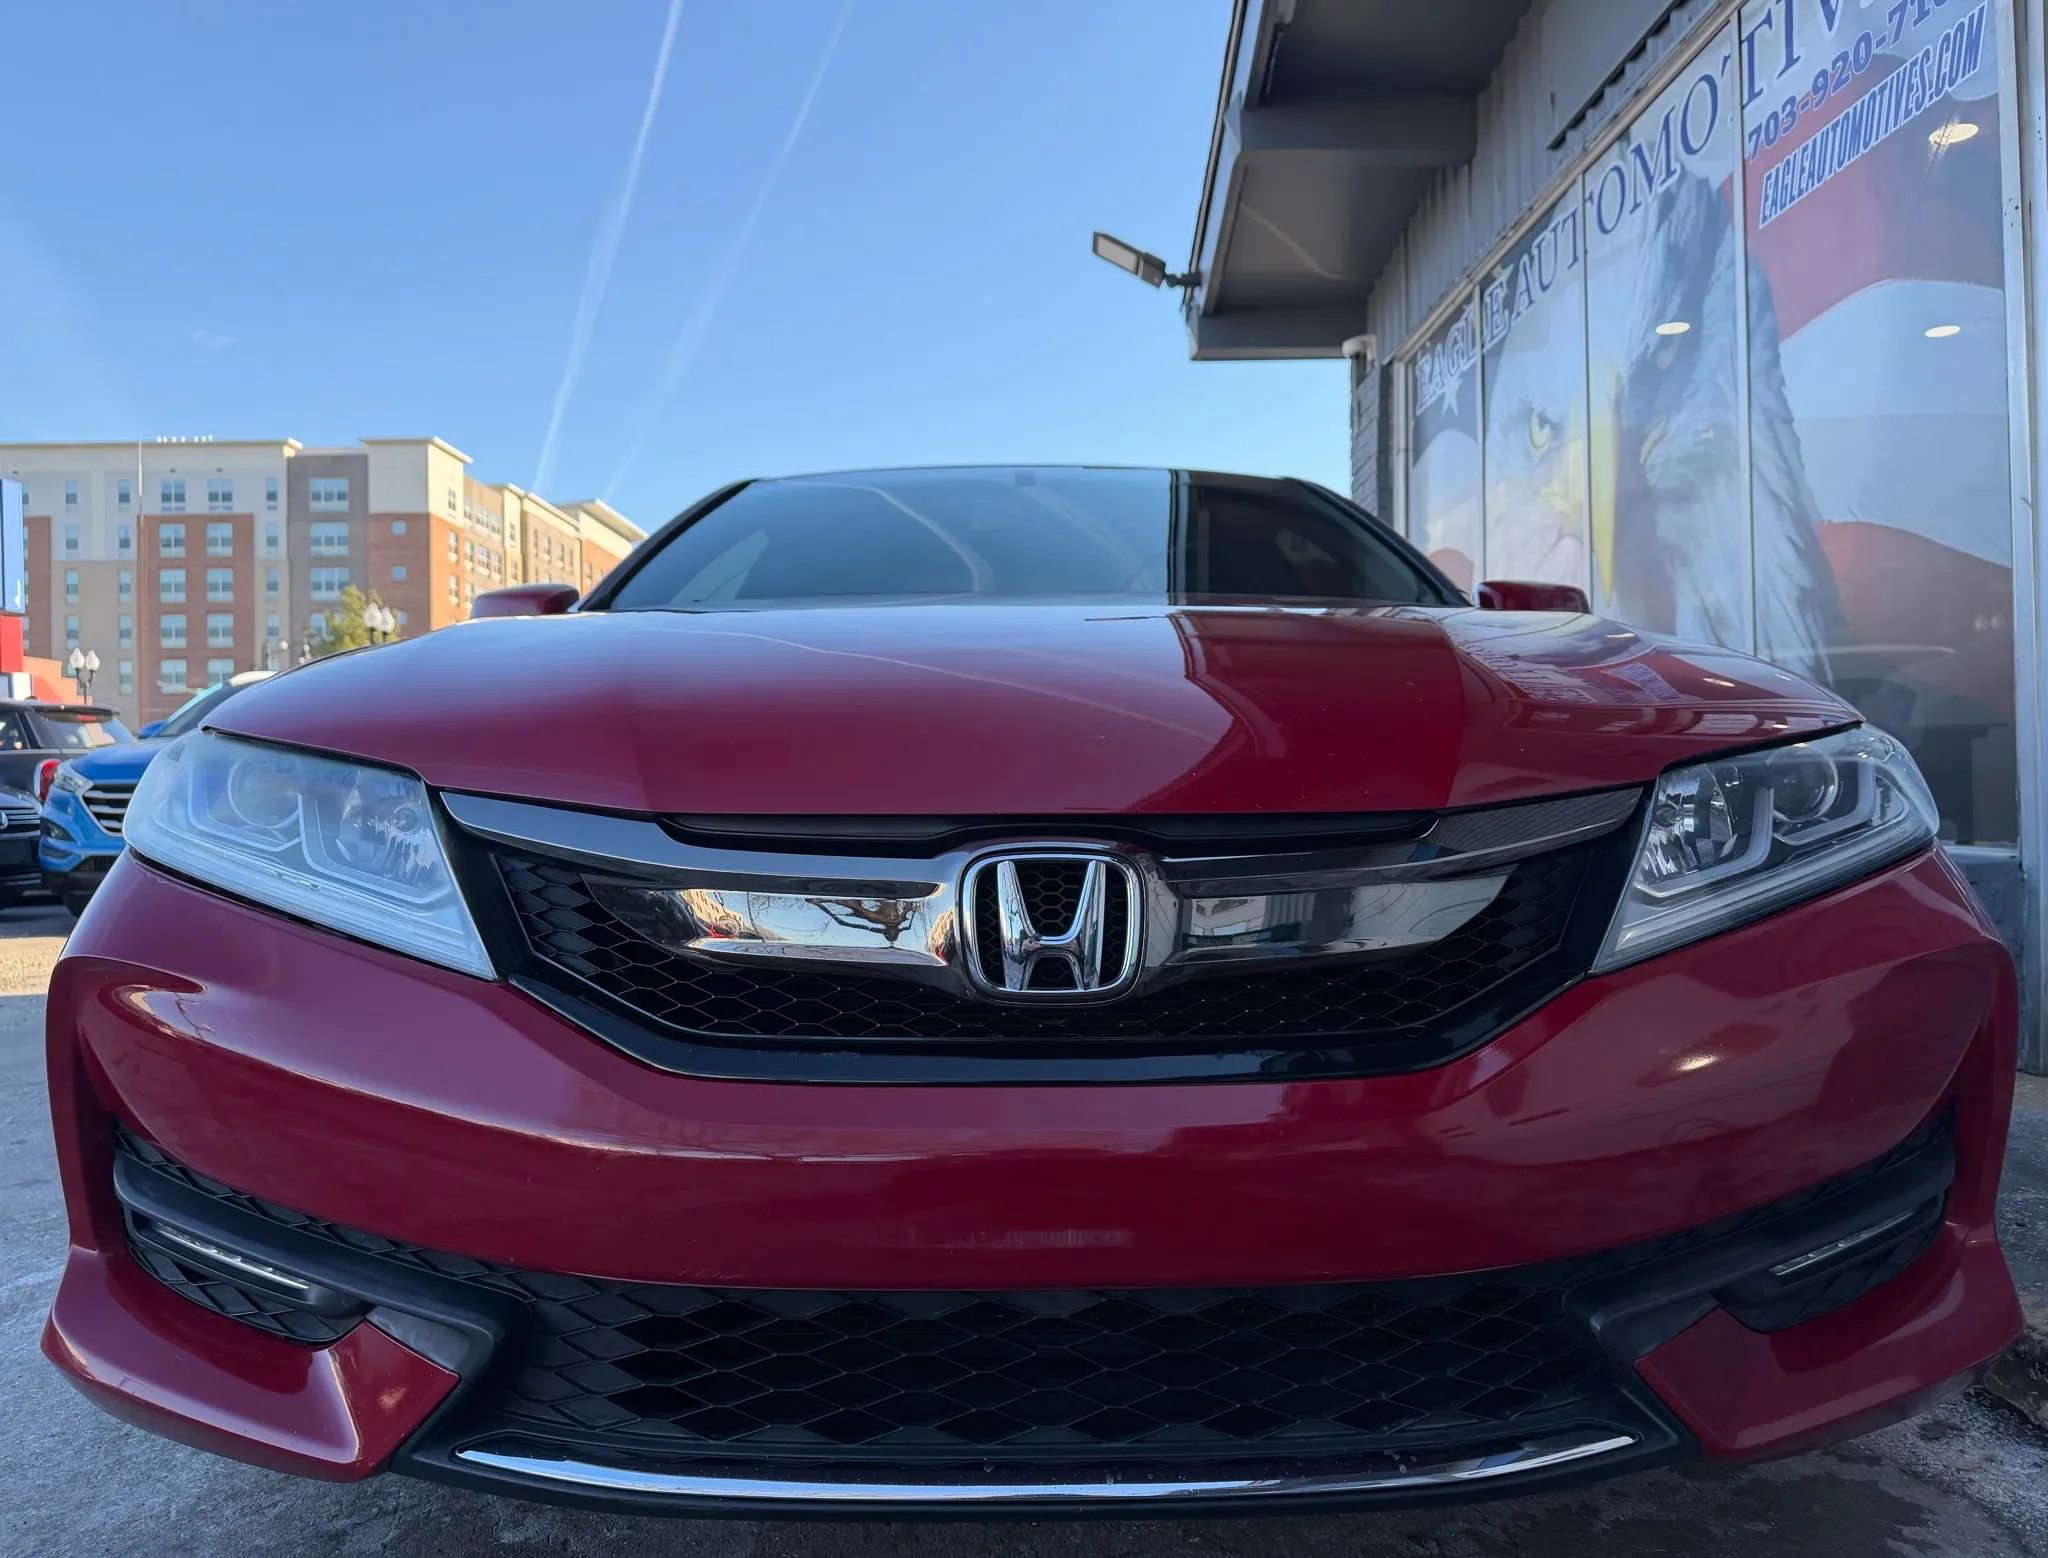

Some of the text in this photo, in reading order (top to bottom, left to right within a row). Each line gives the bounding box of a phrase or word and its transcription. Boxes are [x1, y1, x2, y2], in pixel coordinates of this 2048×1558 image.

[1748, 0, 1949, 163] 703-920-71
[1759, 1, 1987, 229] EAGLEAUTOMOTIVES.COM
[1416, 277, 1511, 415] EAGLE
